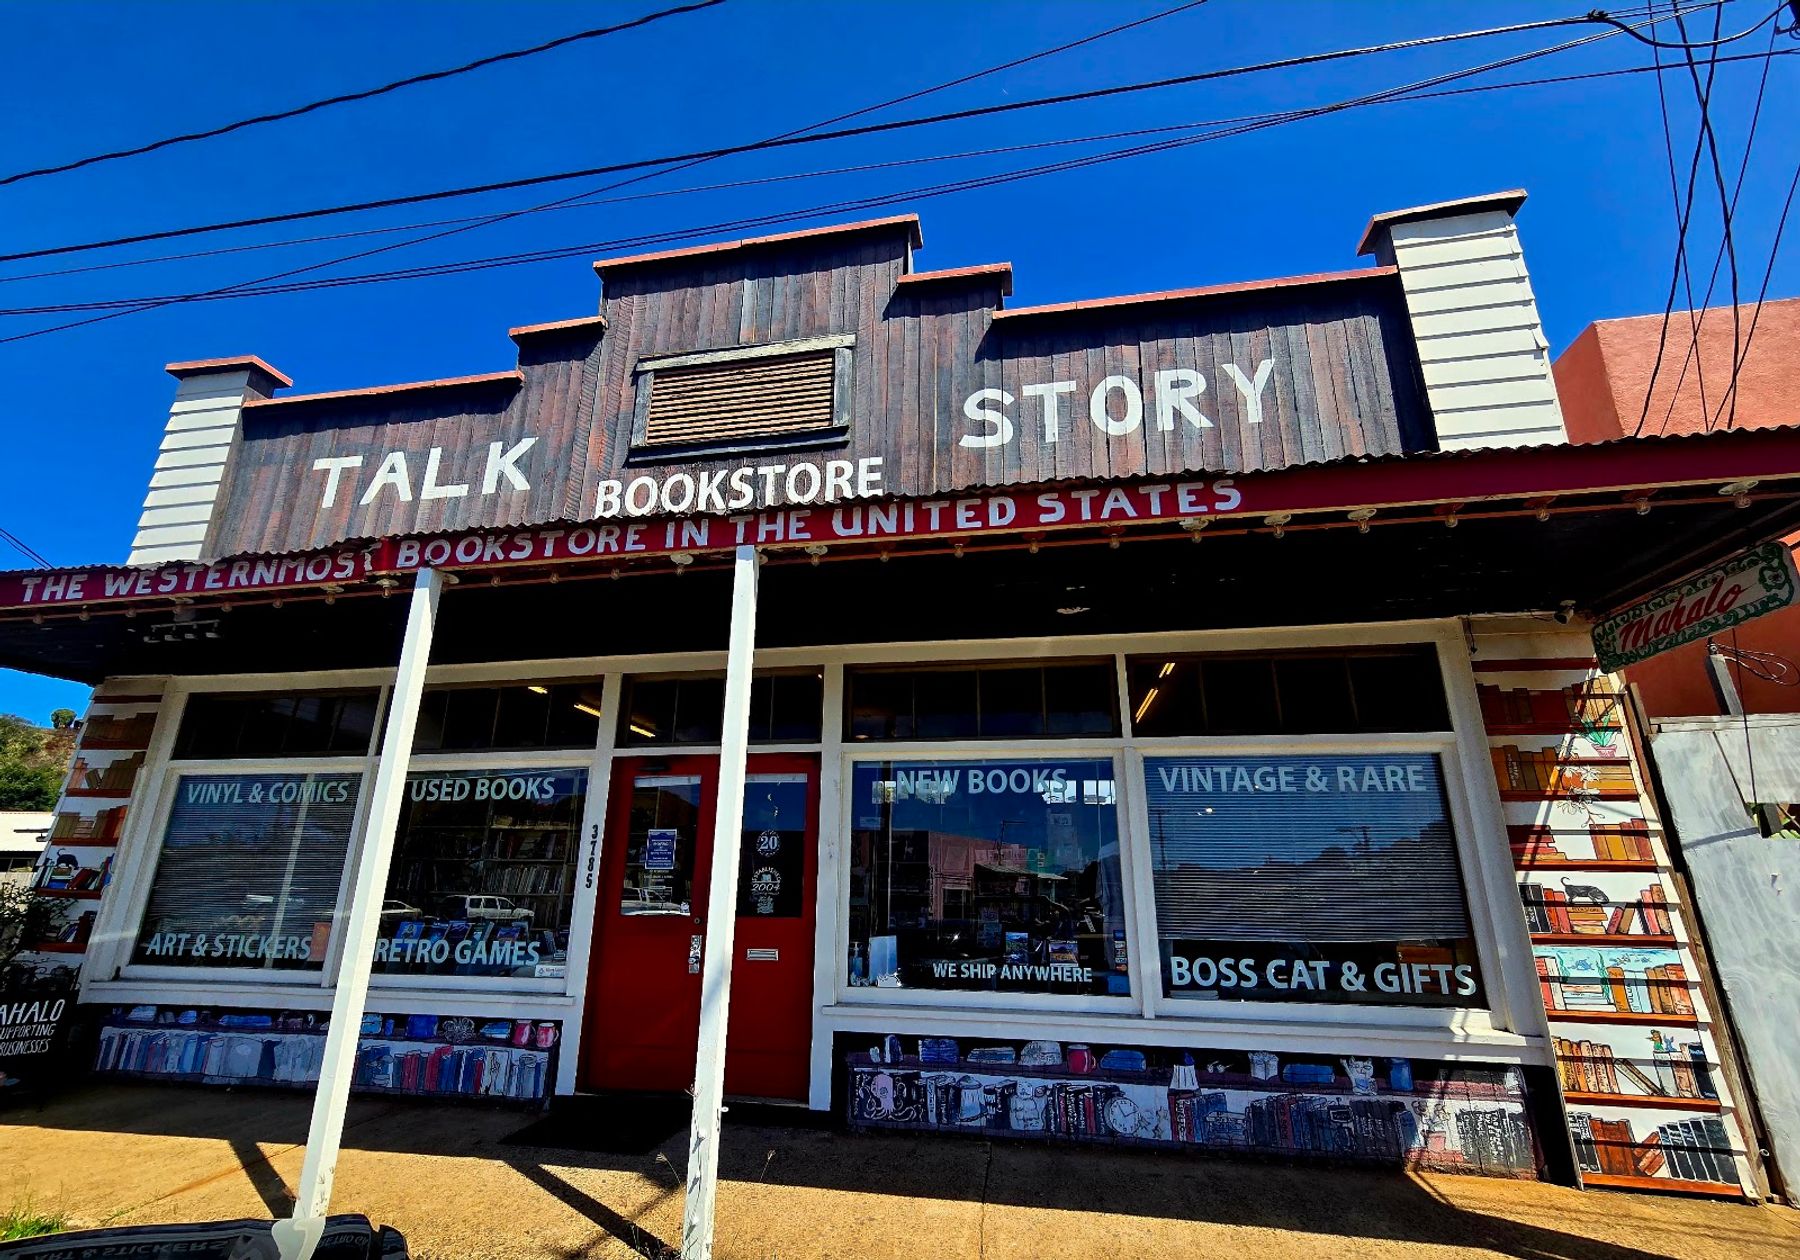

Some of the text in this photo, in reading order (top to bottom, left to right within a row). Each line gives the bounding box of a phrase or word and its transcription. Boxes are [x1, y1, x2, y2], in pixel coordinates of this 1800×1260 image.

[313, 358, 1276, 508] TALK STORY
[594, 456, 884, 519] BOOKSTORE
[22, 479, 1243, 602] THE WESTERNMOST BOOKSTORE IN THE UNITED STATES
[1618, 575, 1752, 652] Mahalo
[187, 780, 349, 805] VINYL & COMICS
[410, 776, 556, 802] USED BOOKS
[896, 768, 1069, 795] NEW BOOKS
[1158, 764, 1427, 793] VINTAGE & RARE
[585, 824, 599, 889] 3785
[760, 835, 779, 850] 20
[146, 932, 311, 960] ART & STICKERS
[373, 938, 541, 967] RETRO GAMES
[932, 963, 1093, 983] WE SHIP ANYWHERE
[1171, 956, 1477, 996] BOSS CAT & GIFTS
